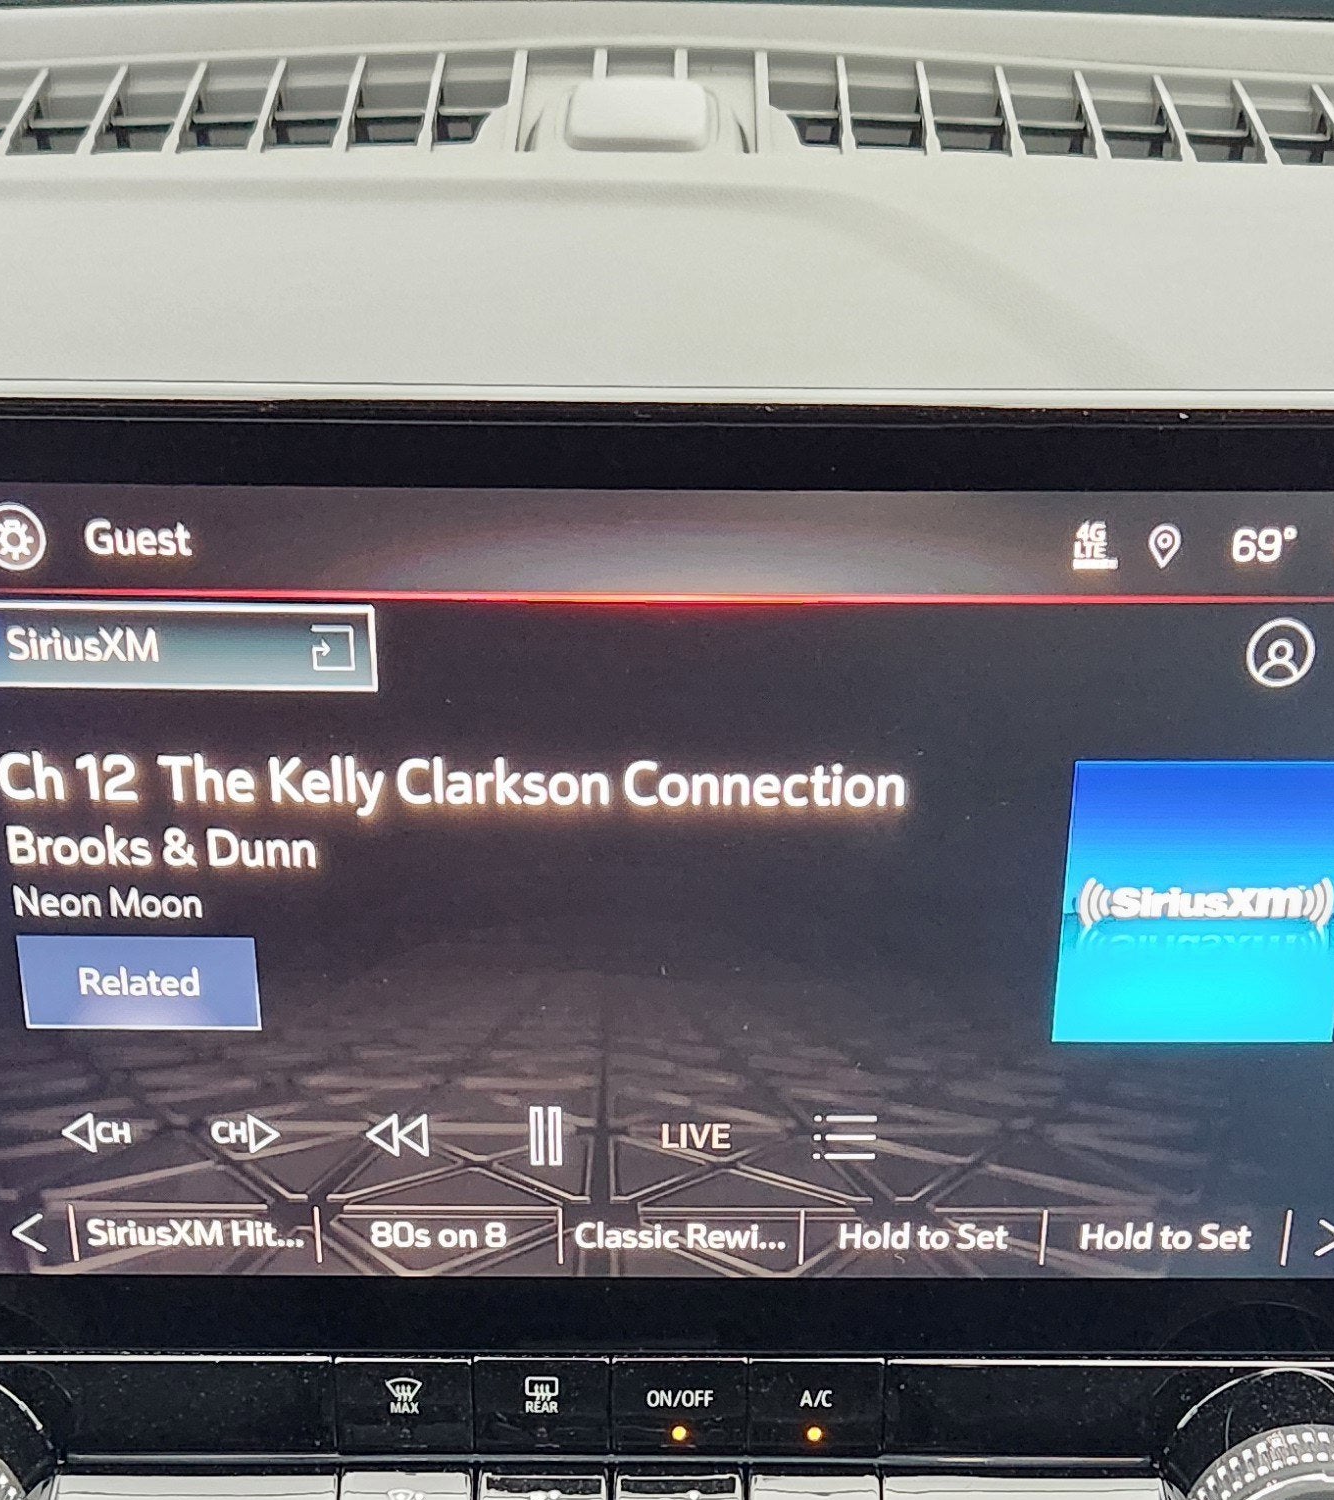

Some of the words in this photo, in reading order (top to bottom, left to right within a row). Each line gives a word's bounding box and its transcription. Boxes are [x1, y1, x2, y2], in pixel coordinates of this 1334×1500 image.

[85, 518, 192, 558] Guest
[1076, 521, 1107, 542] 4G
[1232, 527, 1298, 562] 69°
[1074, 541, 1108, 558] LTE
[6, 627, 160, 664] SiriusXM
[76, 754, 138, 803] 12
[158, 754, 255, 804] The
[268, 757, 385, 817] Kelly
[397, 758, 609, 808] Clarkson
[623, 760, 906, 810] Connection
[5, 827, 152, 867] Brooks
[162, 829, 198, 867] &
[207, 829, 317, 869] Dunn
[13, 885, 102, 918] Neon
[109, 886, 203, 920] Moon
[78, 967, 201, 998] Related
[95, 1119, 131, 1145] CH
[210, 1119, 247, 1146] CH
[660, 1122, 731, 1150] LIVE
[86, 1219, 226, 1248] SiriusXM
[370, 1222, 427, 1250] 80s
[436, 1228, 476, 1249] on
[485, 1222, 508, 1249] 8
[574, 1222, 677, 1251] Classic
[838, 1223, 905, 1251] Hold
[915, 1226, 950, 1251] to
[955, 1224, 1009, 1252] Set
[1079, 1224, 1152, 1252] Hold
[1159, 1227, 1192, 1252] to
[1197, 1225, 1252, 1252] Set
[389, 1400, 420, 1414] MAX
[524, 1400, 559, 1414] REAR
[646, 1389, 714, 1408] ON/OFF
[799, 1389, 833, 1408] A/C
